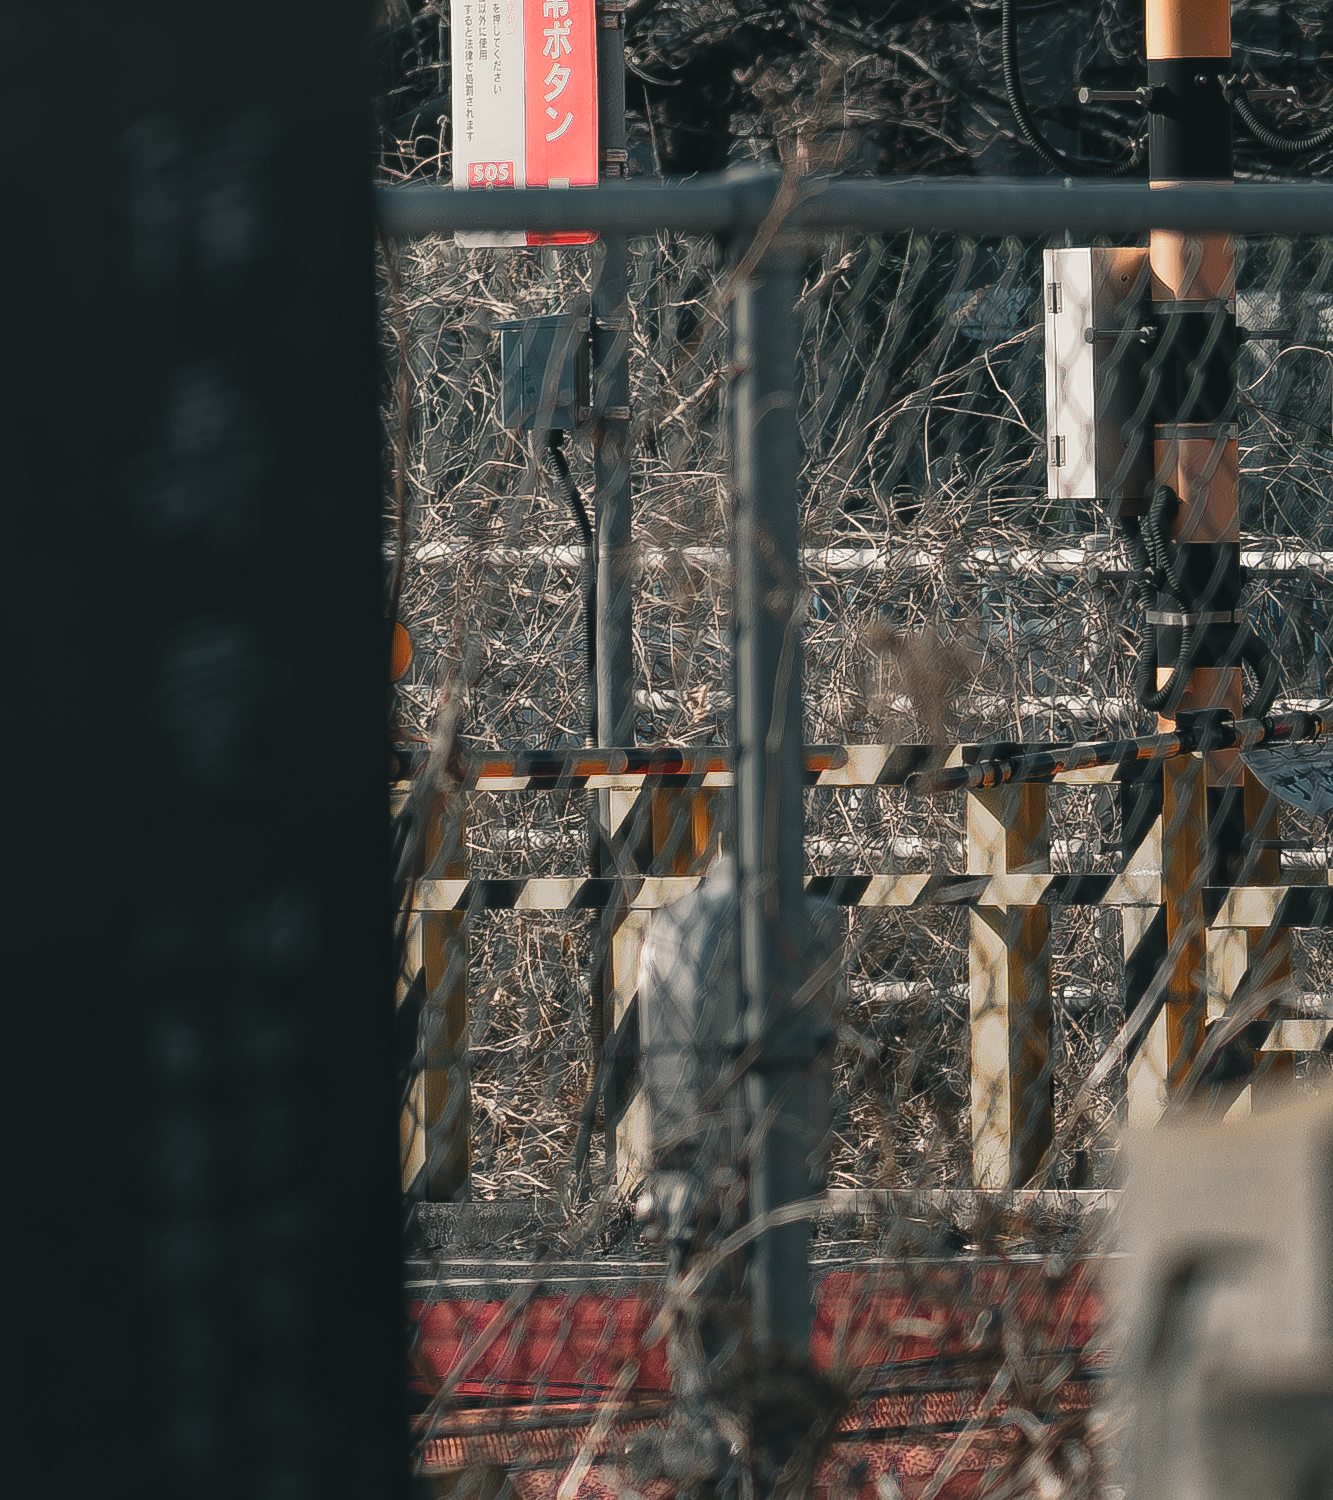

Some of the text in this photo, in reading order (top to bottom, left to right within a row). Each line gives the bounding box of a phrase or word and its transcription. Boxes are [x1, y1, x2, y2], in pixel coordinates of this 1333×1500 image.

[463, 4, 475, 143] すると法律で処罰されます
[492, 2, 502, 95] を押してください
[473, 163, 510, 182] SOS
